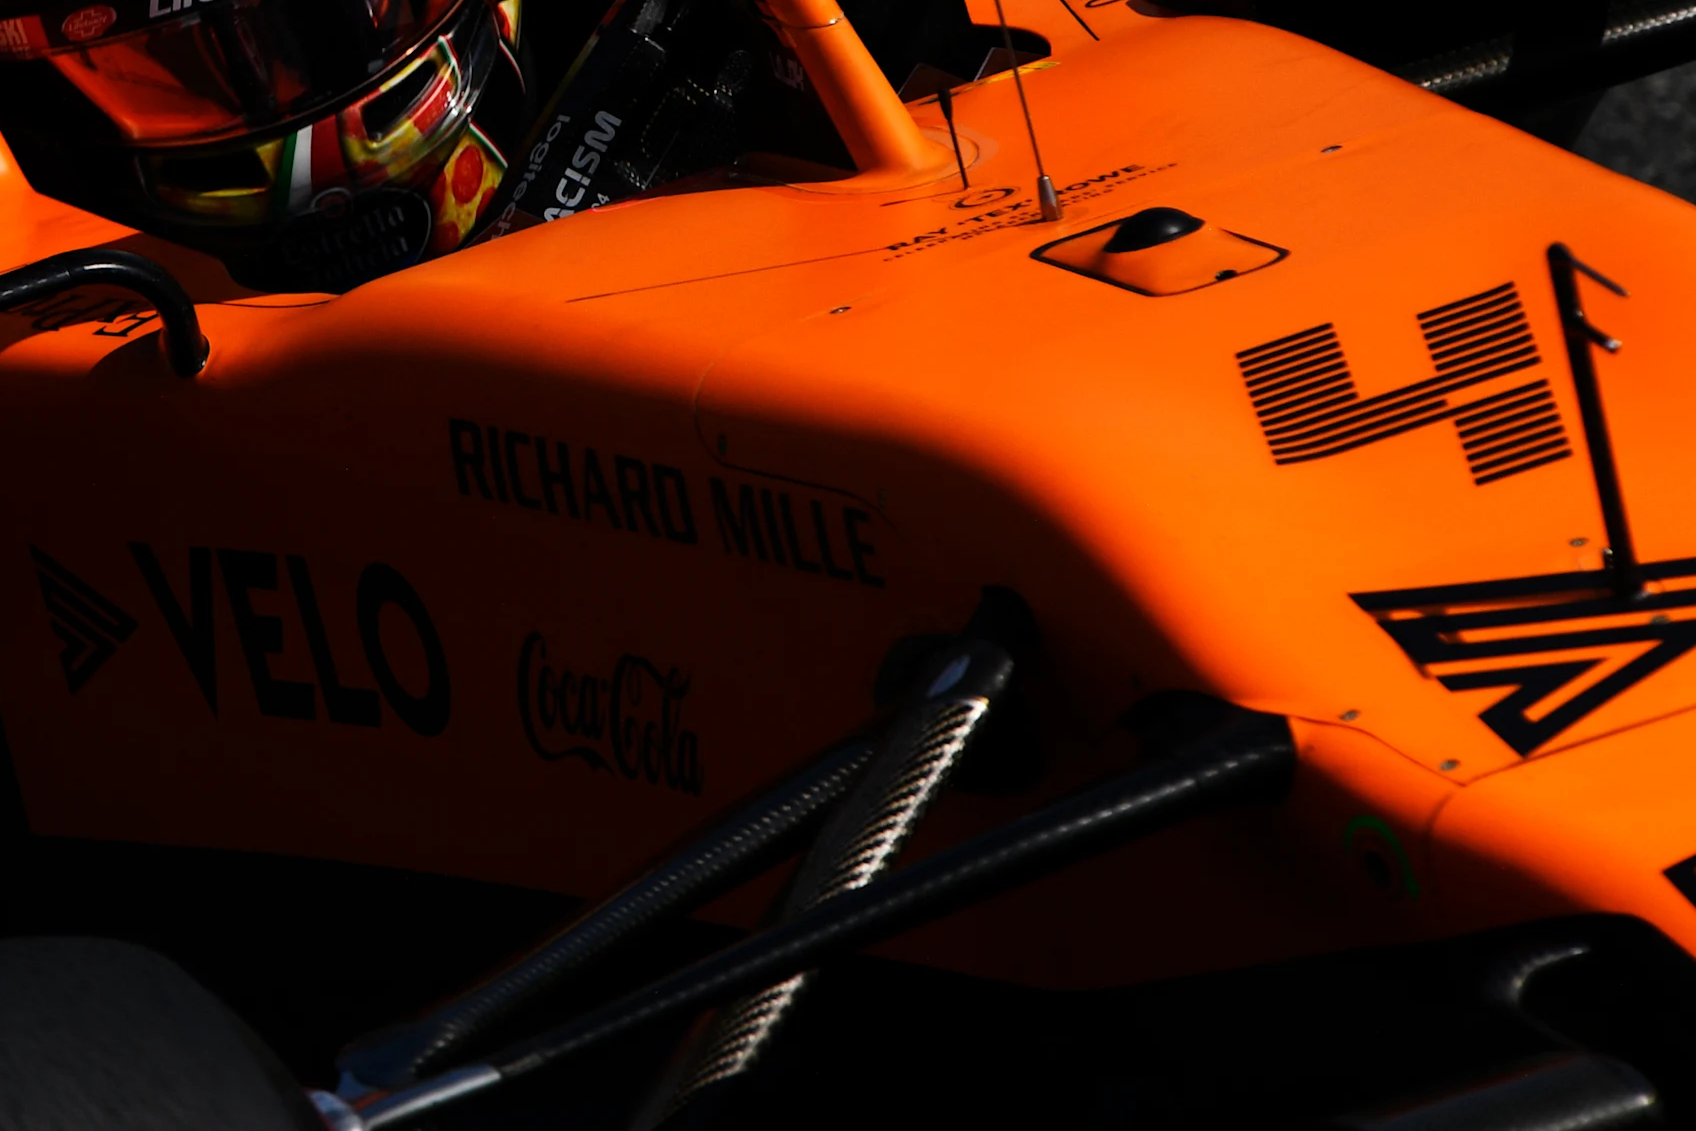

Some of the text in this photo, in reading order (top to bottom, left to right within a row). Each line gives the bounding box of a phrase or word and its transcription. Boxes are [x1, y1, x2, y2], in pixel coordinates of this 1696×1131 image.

[449, 418, 886, 589] RICHARD MILLE
[127, 541, 451, 737] VELO
